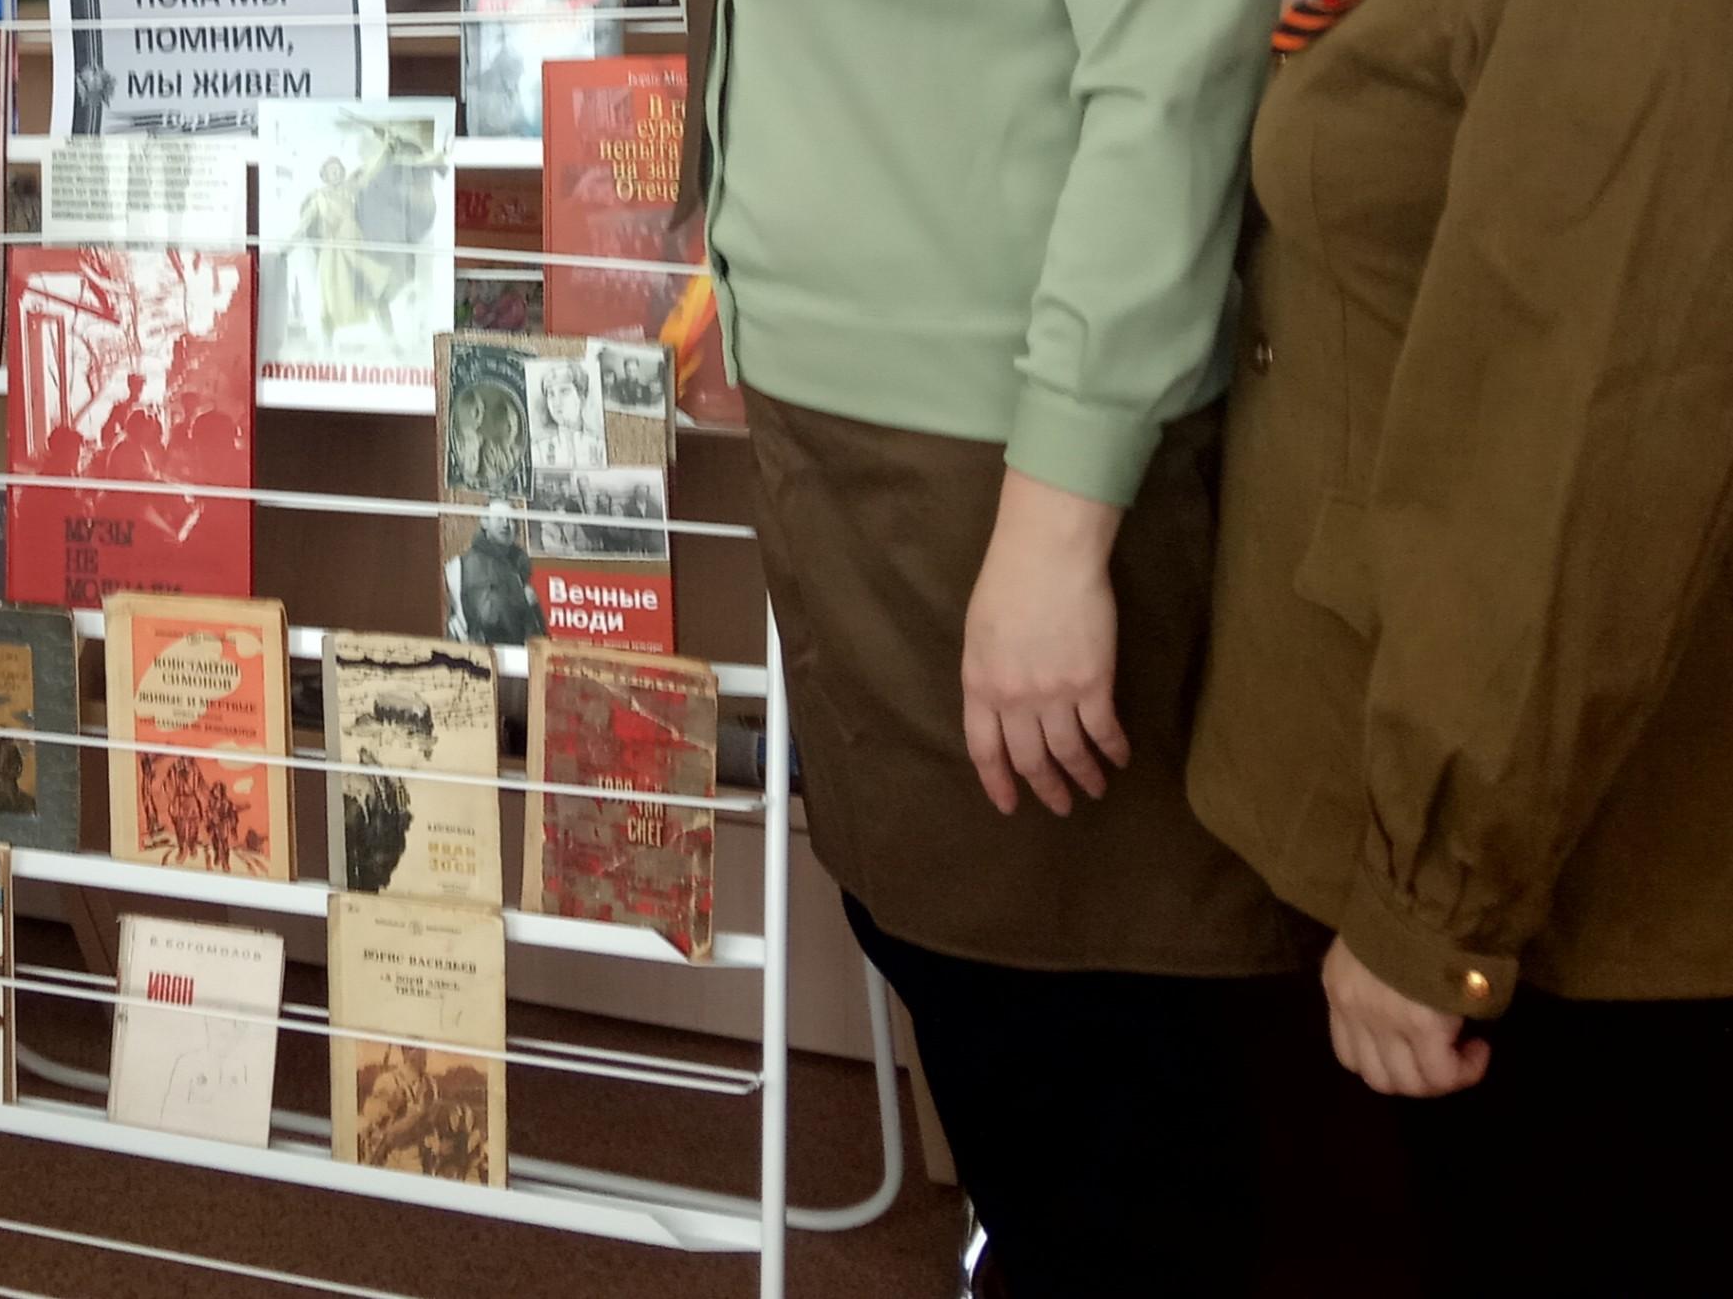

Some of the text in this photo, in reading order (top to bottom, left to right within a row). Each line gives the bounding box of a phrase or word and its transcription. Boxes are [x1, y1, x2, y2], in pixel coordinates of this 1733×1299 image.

[134, 24, 294, 57] ПОМНИМ,
[127, 68, 312, 99] МЫ ЖИВЕМ
[548, 576, 658, 610] Вечные
[549, 606, 624, 635] люди
[627, 816, 663, 847] СНЕГ
